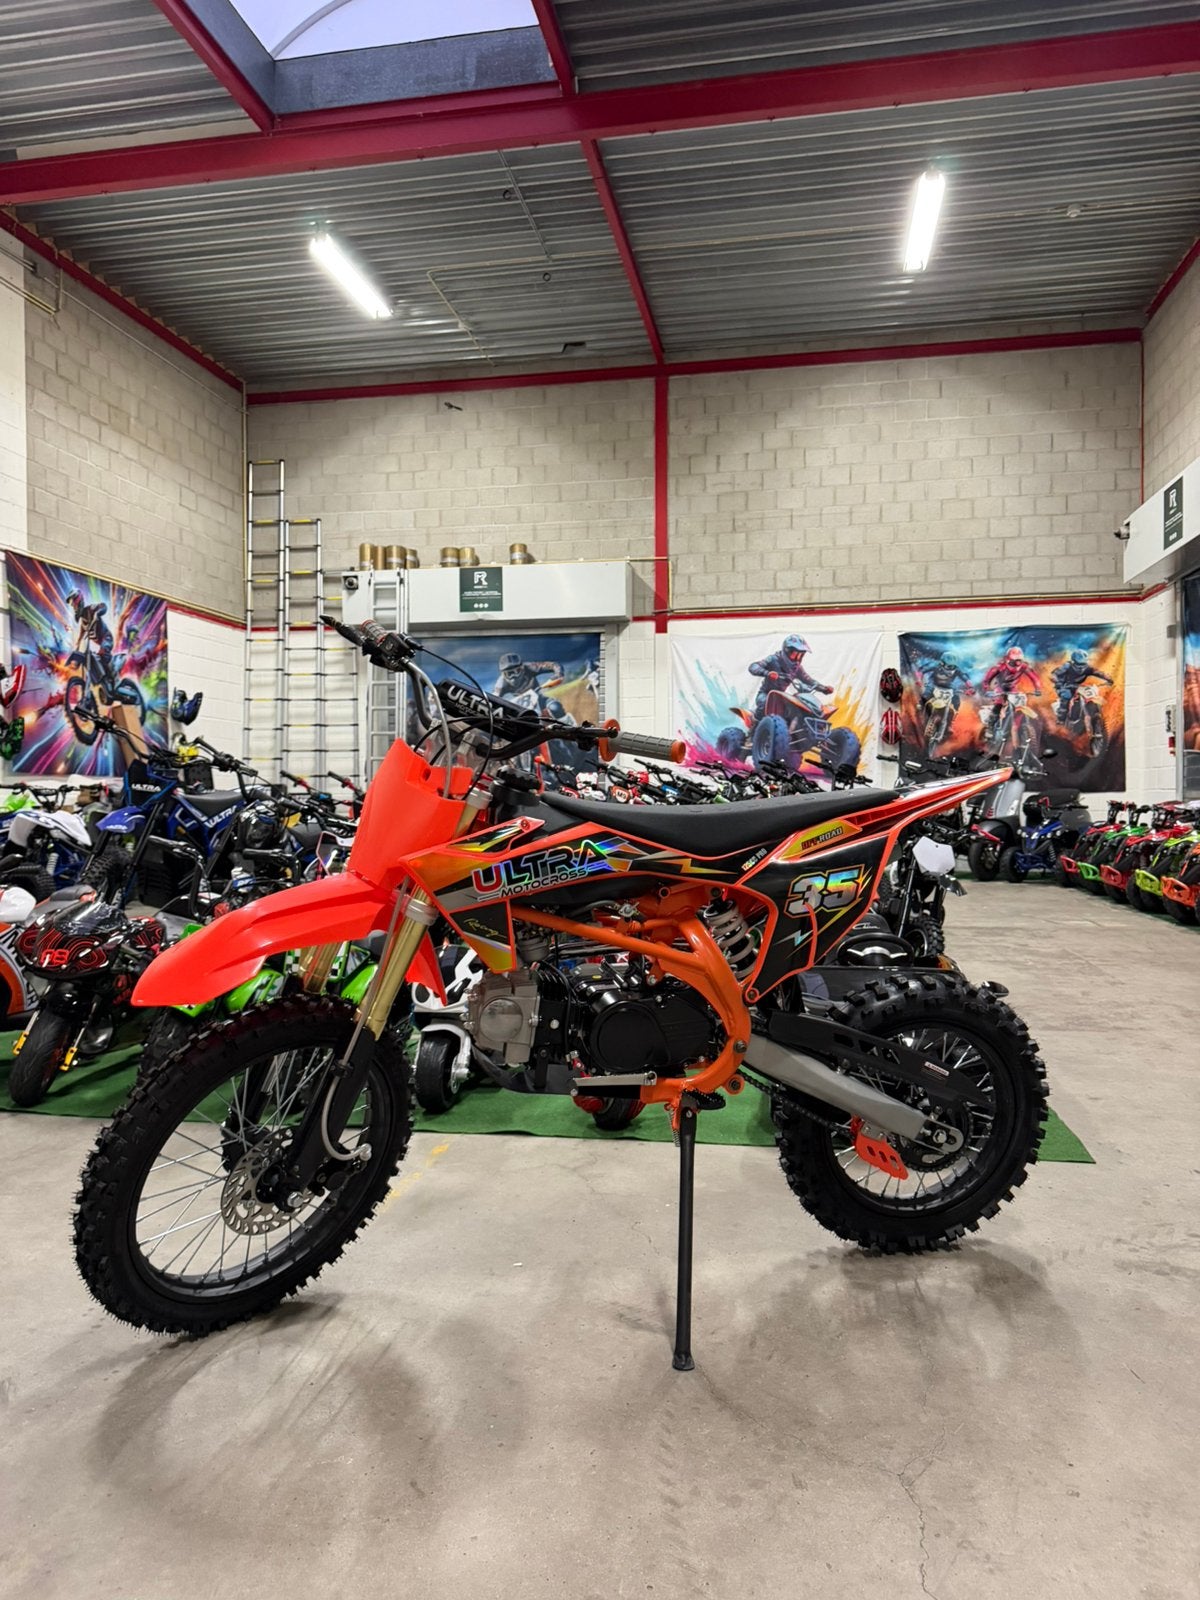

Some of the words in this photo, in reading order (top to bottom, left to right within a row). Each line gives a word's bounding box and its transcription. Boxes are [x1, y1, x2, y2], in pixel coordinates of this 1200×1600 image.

[447, 685, 504, 719] ULTRA
[131, 783, 161, 792] ULTRA
[471, 839, 607, 893] ULTRA
[501, 867, 588, 898] MOTOCROSS
[784, 864, 865, 919] 35
